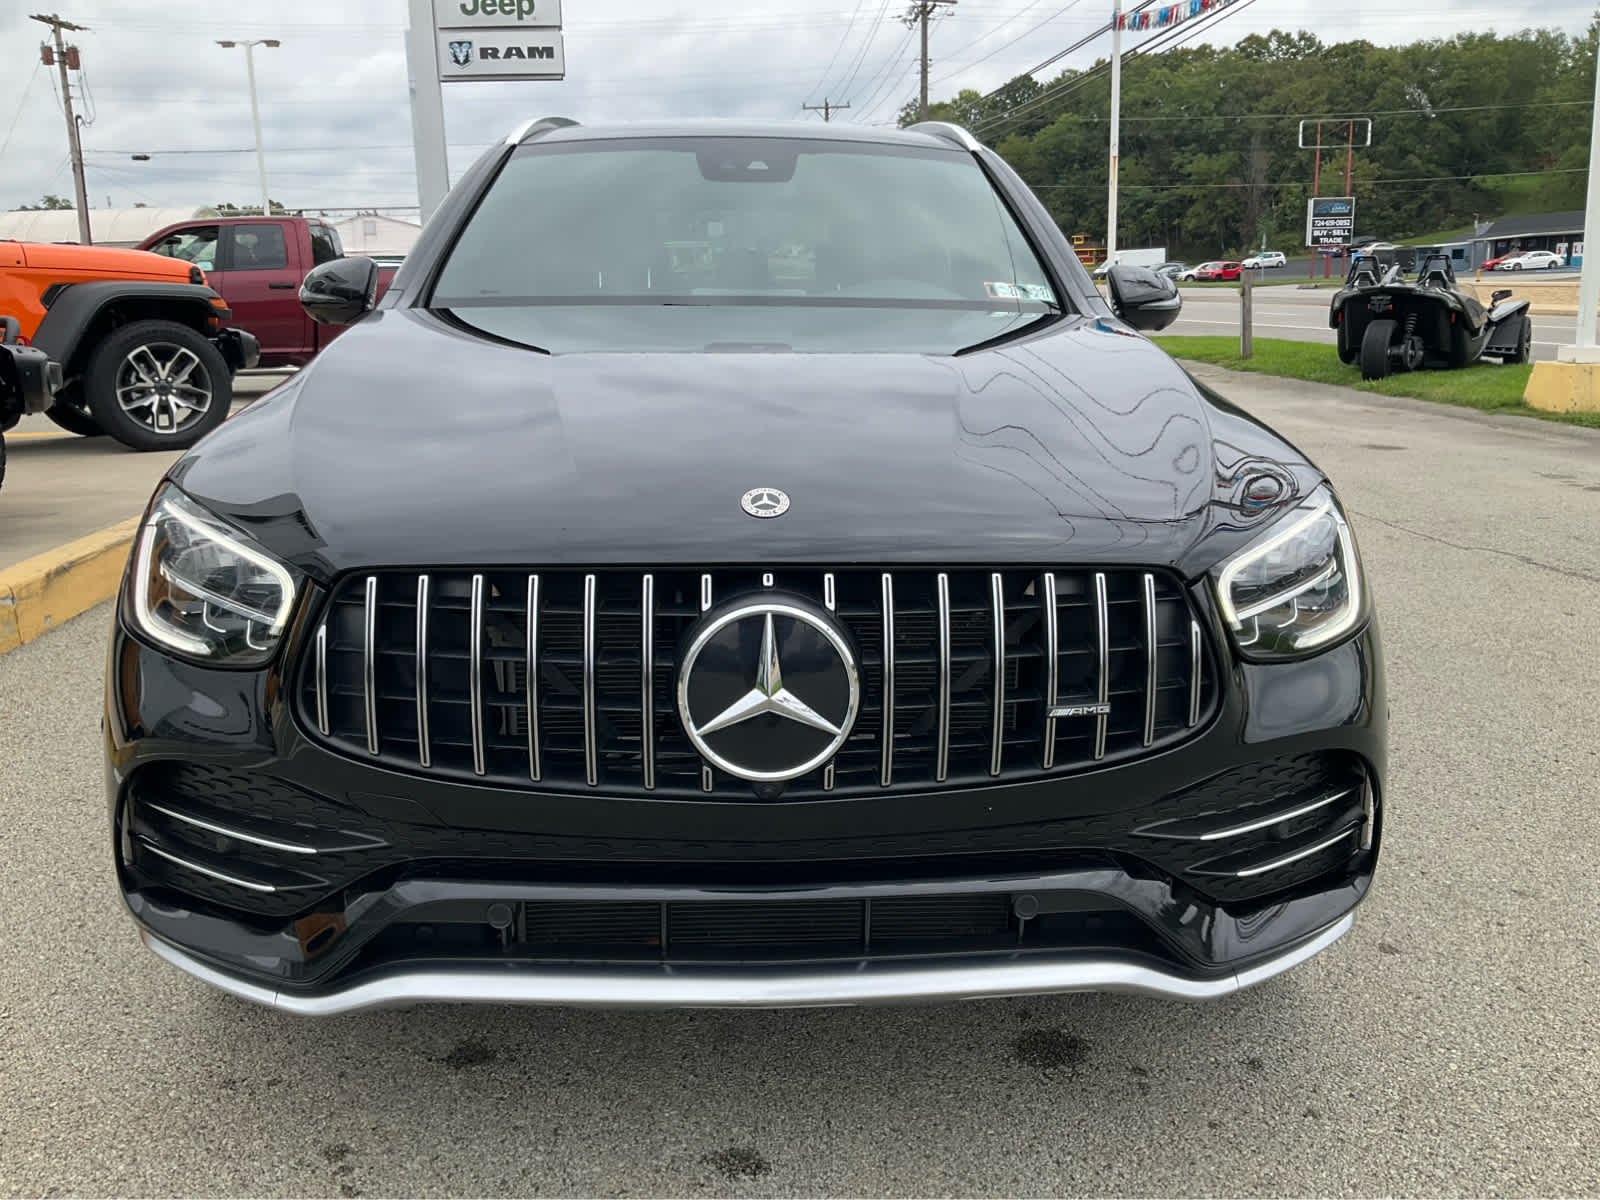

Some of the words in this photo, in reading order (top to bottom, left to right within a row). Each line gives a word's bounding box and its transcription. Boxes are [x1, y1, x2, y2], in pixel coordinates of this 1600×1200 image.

[459, 0, 535, 21] Jeep
[479, 46, 555, 60] RAM
[1066, 703, 1111, 716] AMG
